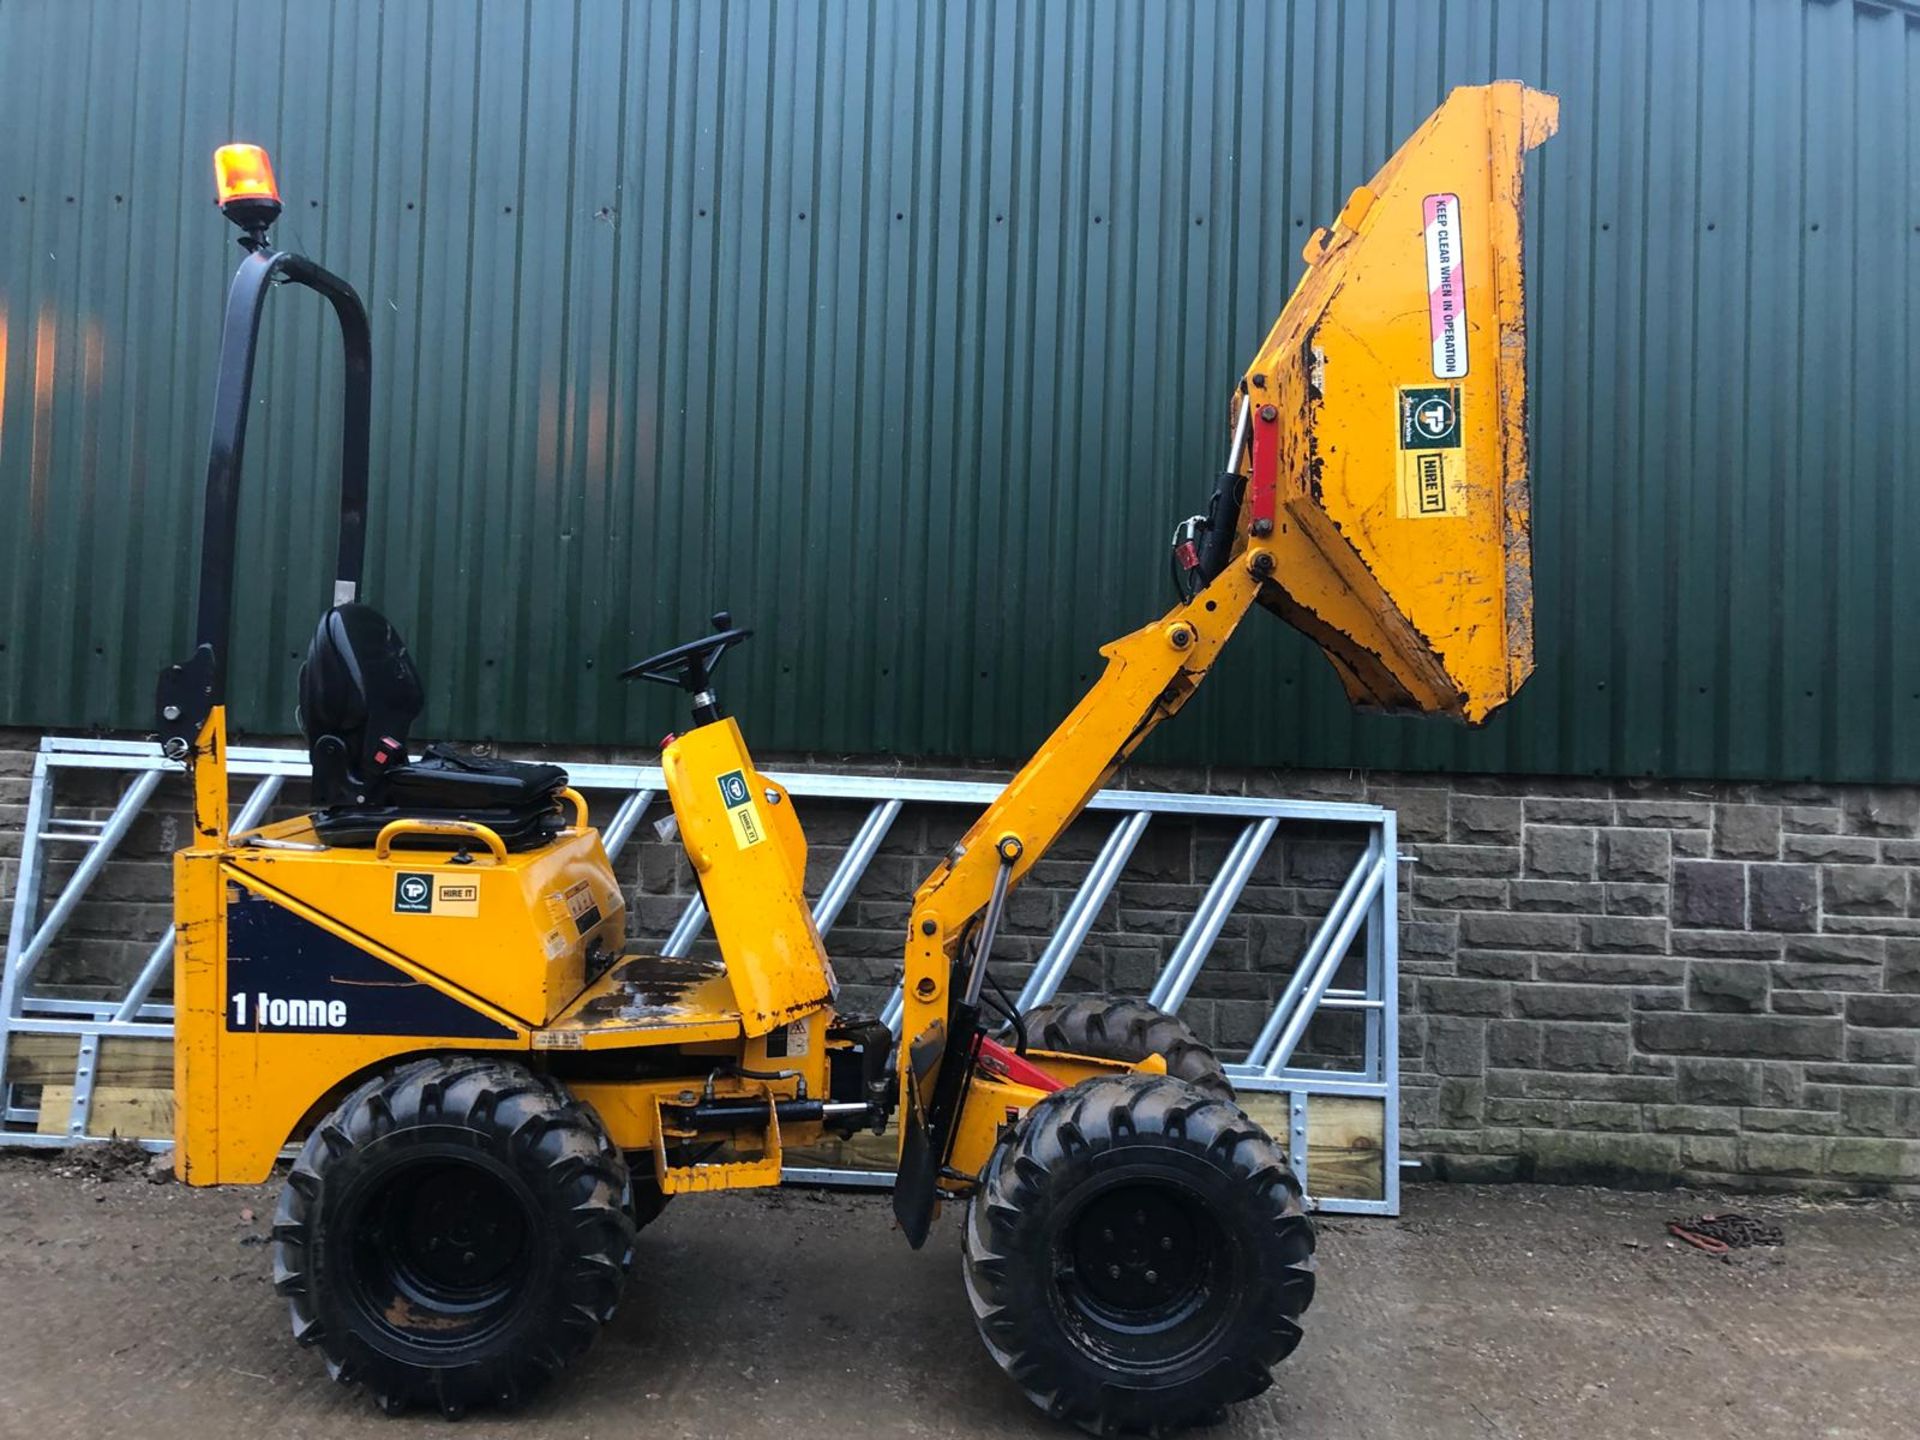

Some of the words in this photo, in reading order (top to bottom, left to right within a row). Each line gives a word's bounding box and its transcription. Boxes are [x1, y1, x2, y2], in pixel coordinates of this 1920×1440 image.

[1436, 200, 1448, 226] KEEP
[1438, 230, 1450, 263] CLEAR
[1440, 265, 1453, 297] WHEN
[1443, 300, 1453, 311] IN
[1443, 314, 1456, 373] OPERATION
[1424, 406, 1444, 433] TP
[1424, 460, 1438, 491] HIRE
[1426, 494, 1439, 506] IT
[406, 884, 424, 897] TP
[443, 889, 463, 898] HIRE
[465, 889, 473, 898] IT
[232, 992, 246, 1025] 1
[258, 992, 347, 1027] tonne
